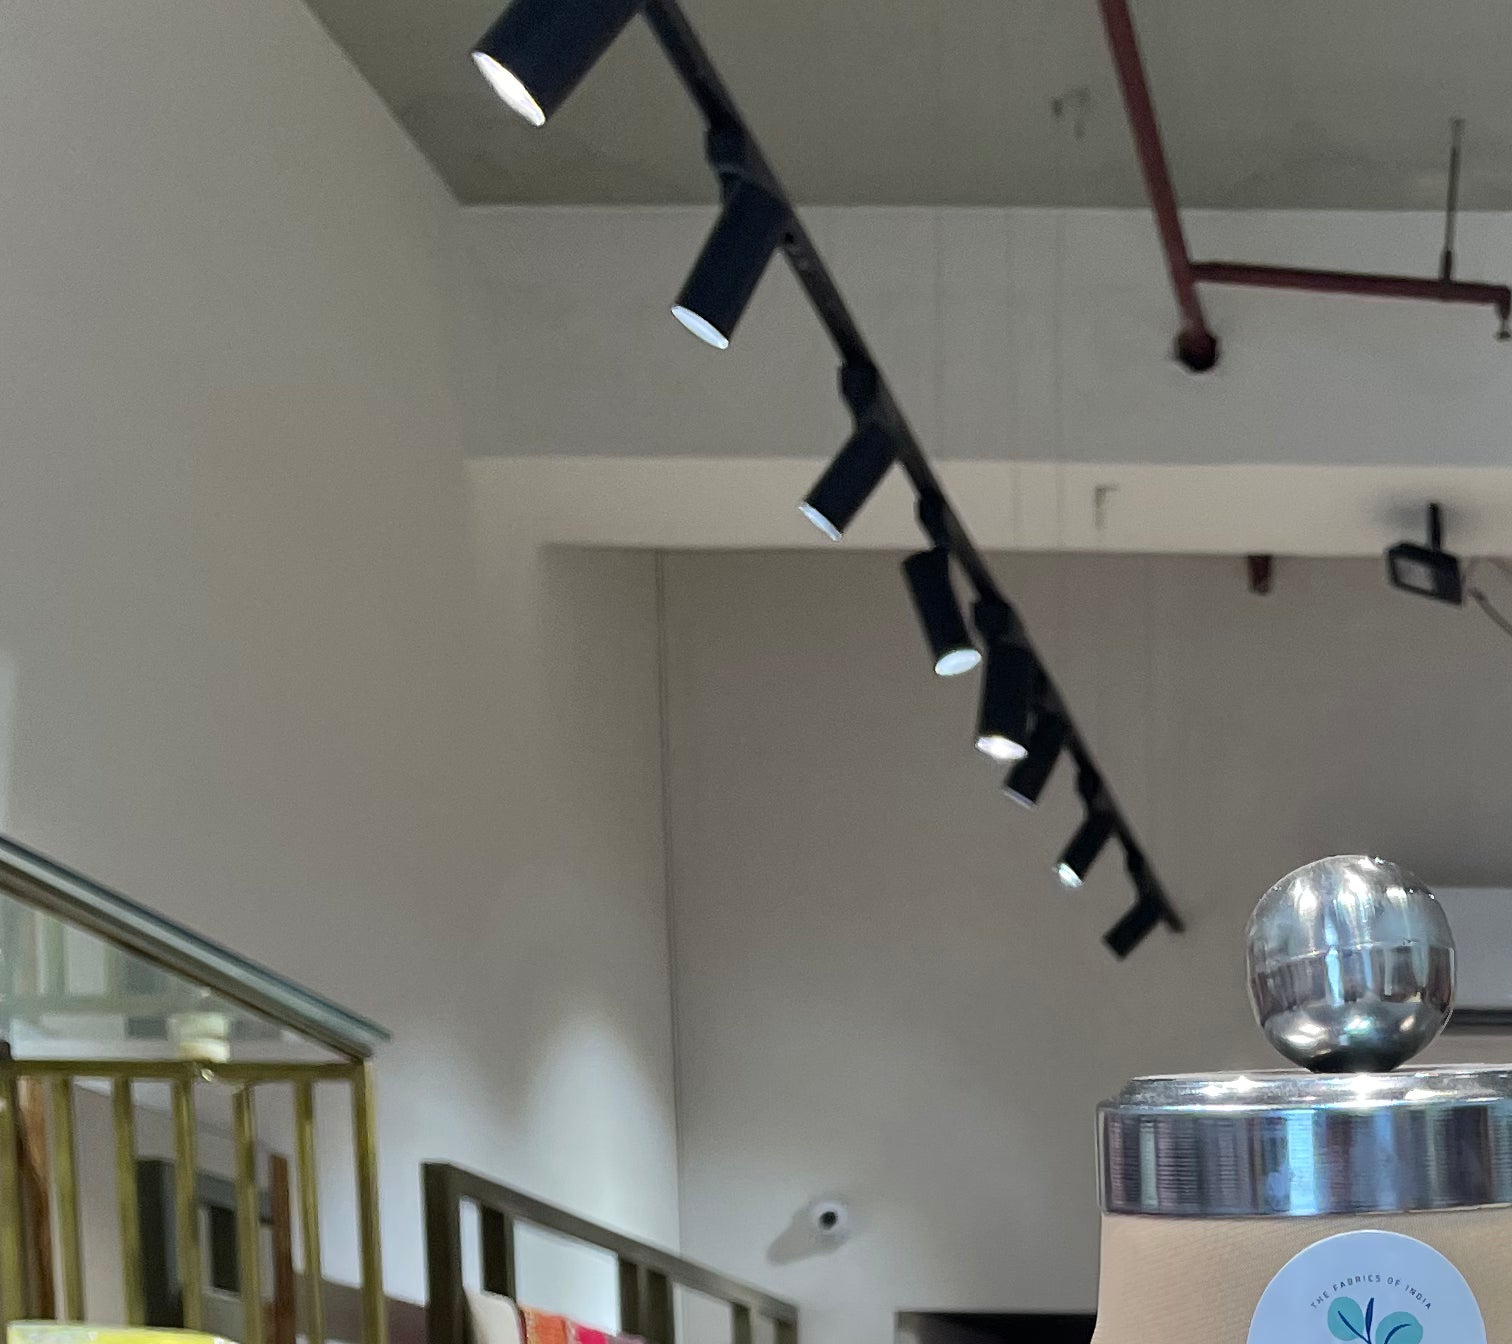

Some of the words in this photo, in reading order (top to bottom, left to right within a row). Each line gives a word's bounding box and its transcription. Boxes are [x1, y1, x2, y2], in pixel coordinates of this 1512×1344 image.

[1310, 1290, 1330, 1309] THE
[1332, 1274, 1381, 1292] FABRICS
[1387, 1276, 1401, 1288] OF
[1404, 1284, 1432, 1310] INDIA
